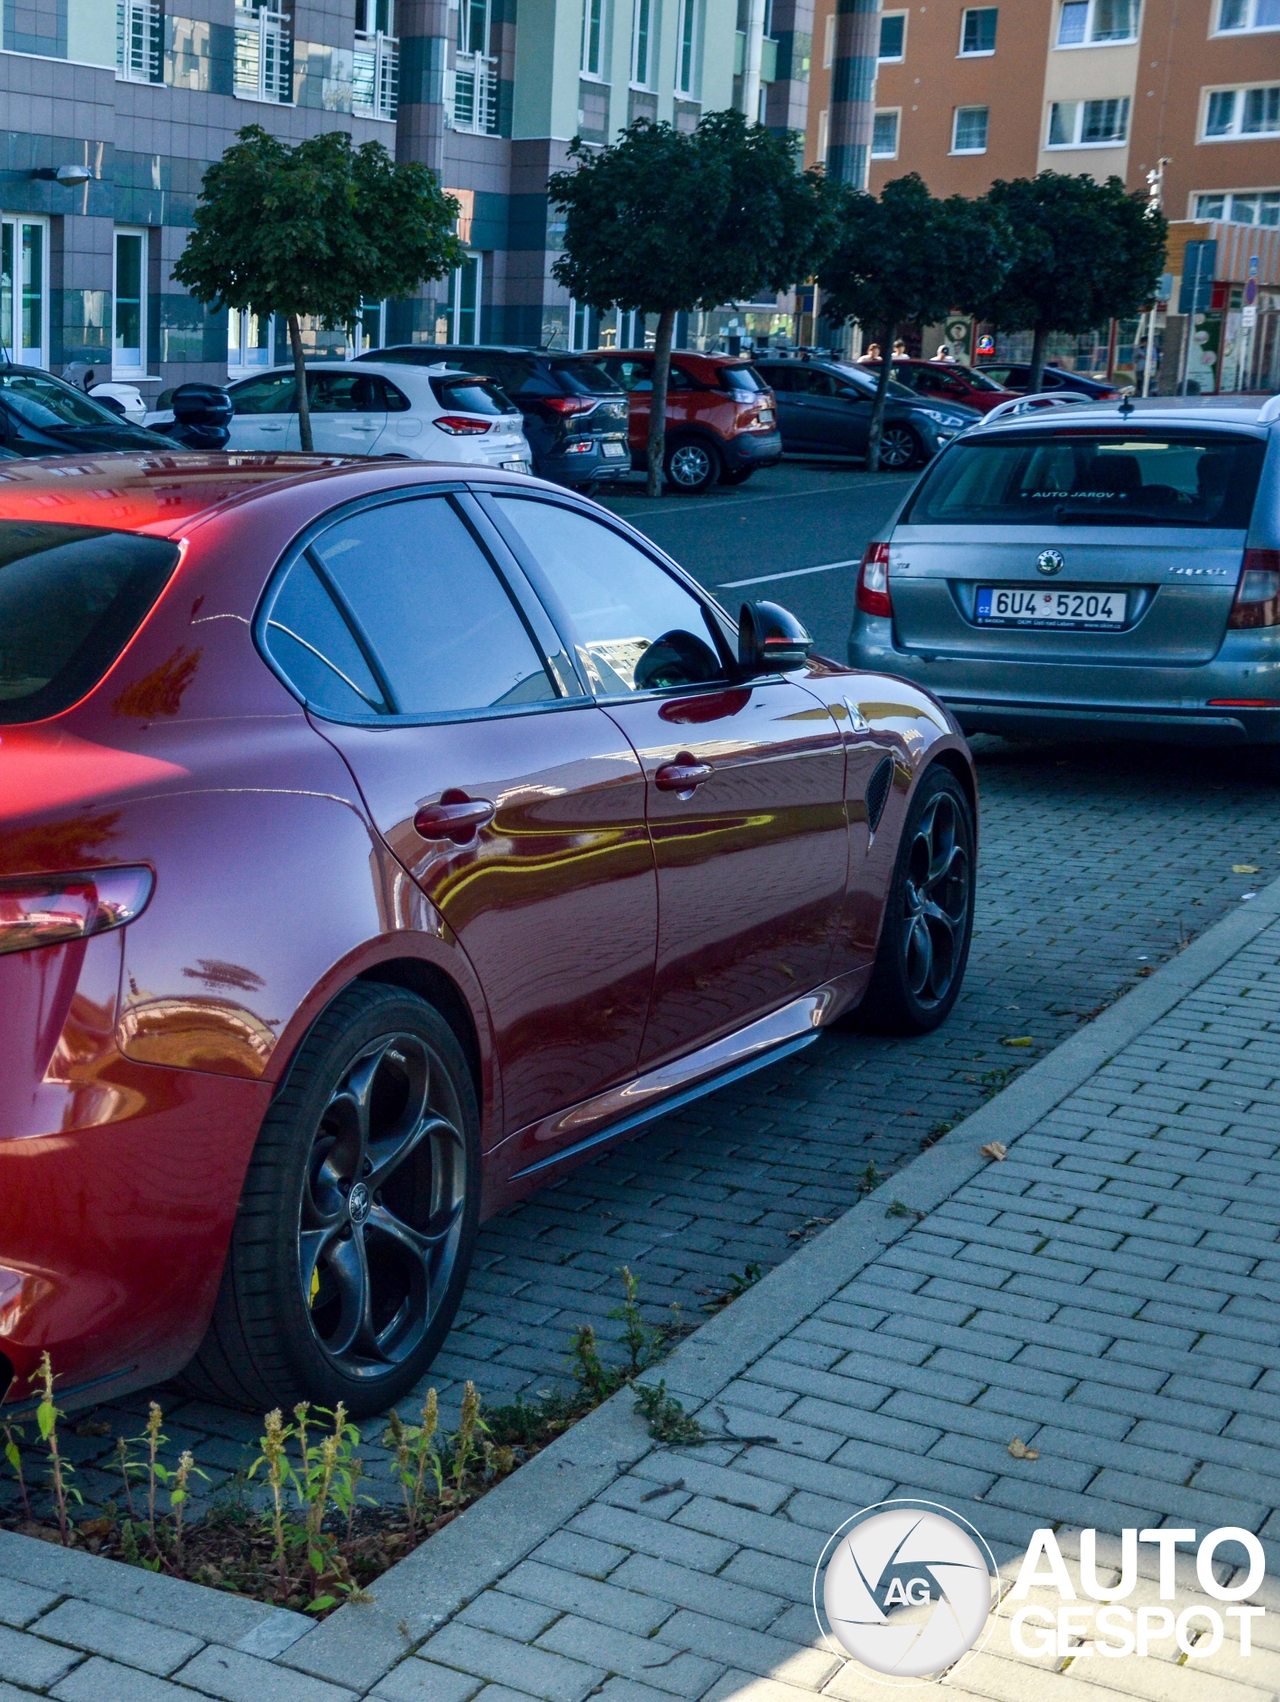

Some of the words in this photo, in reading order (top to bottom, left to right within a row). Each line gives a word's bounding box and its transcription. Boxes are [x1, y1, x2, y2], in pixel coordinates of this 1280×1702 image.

[979, 606, 990, 614] CZ
[996, 592, 1037, 615] 6U4
[1056, 594, 1113, 618] 5204
